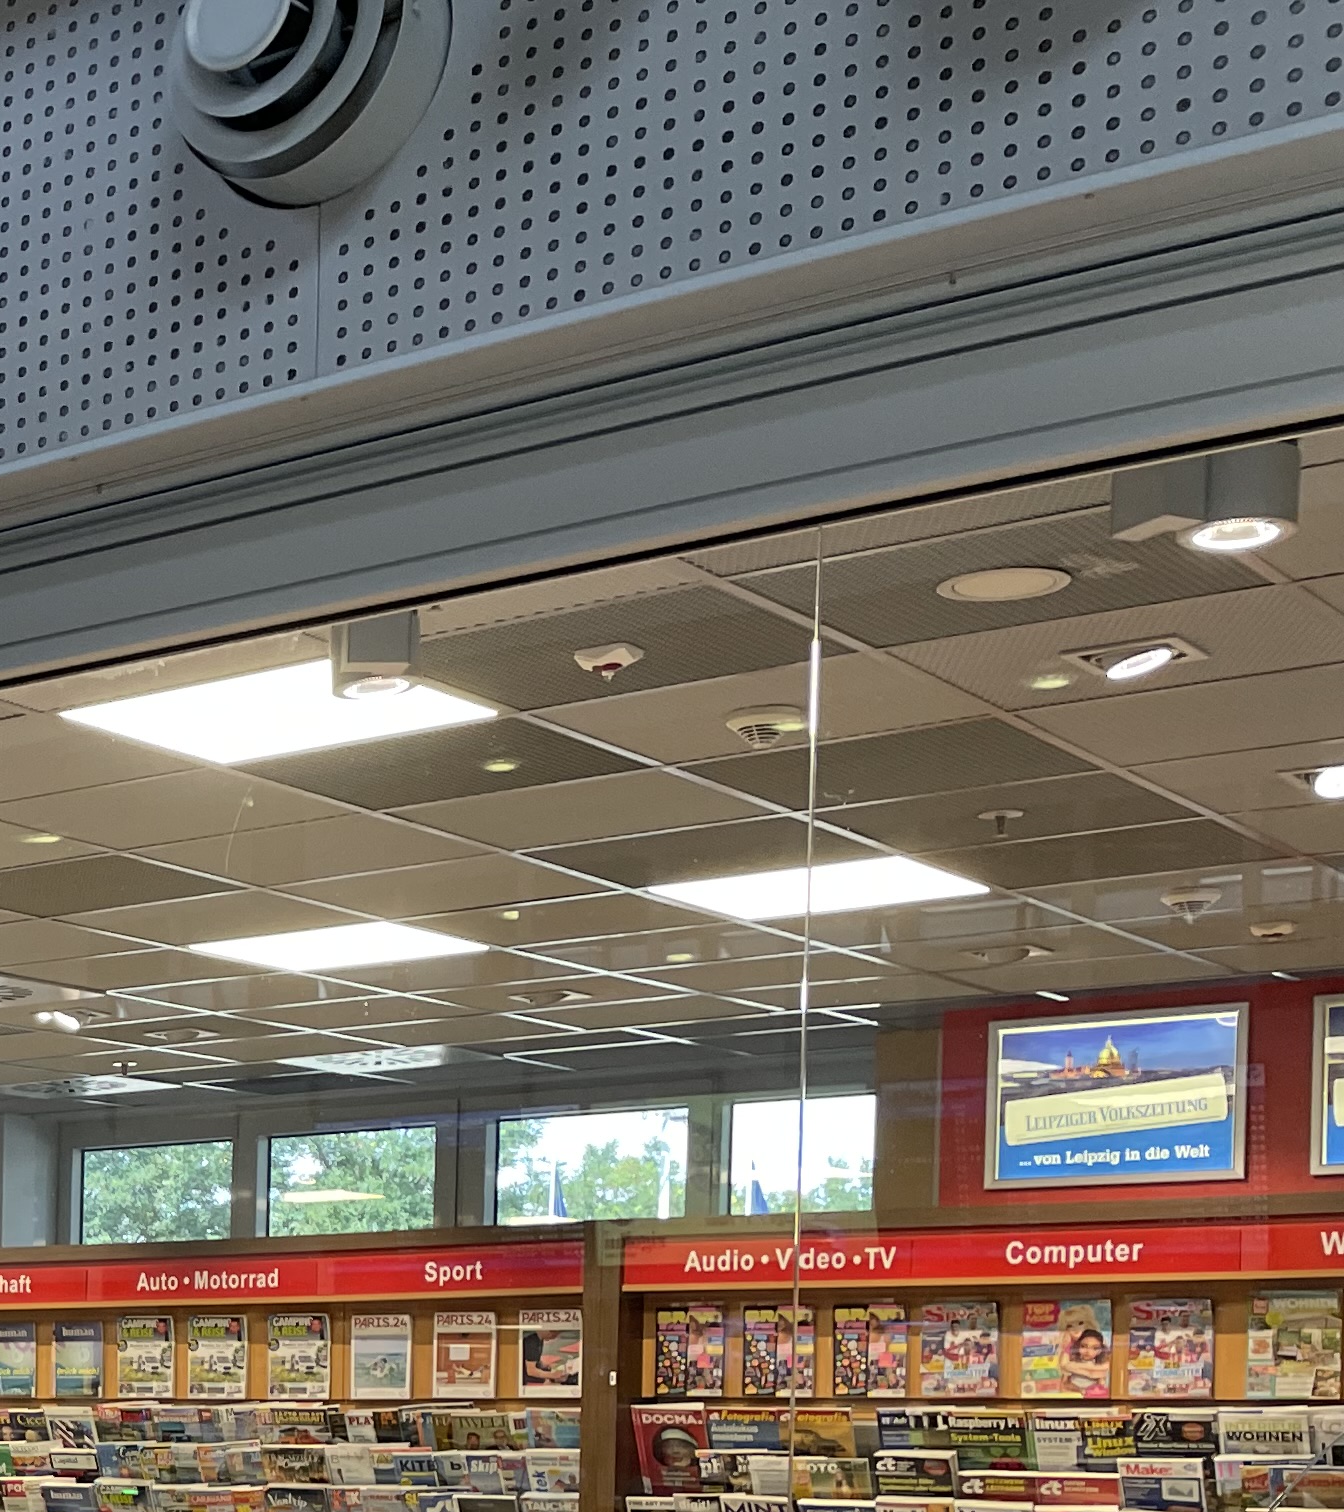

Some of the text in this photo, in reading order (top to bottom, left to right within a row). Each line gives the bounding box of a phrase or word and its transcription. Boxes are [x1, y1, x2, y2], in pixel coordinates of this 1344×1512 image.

[1025, 1097, 1209, 1132] LEIPZIGER VOLKSZEITUNG
[1033, 1144, 1210, 1166] von Leipzig in die Welt
[684, 1246, 896, 1272] Audio Vdeo TV
[1005, 1239, 1144, 1268] Computer
[136, 1268, 280, 1292] Auto Motorrad
[424, 1261, 483, 1287] Sport
[353, 1316, 408, 1329] PARIS.24
[436, 1313, 492, 1326] PARIS.24
[521, 1311, 580, 1323] PARIS.24
[948, 1416, 1006, 1430] Raspberry
[1226, 1431, 1304, 1443] WOHNEN
